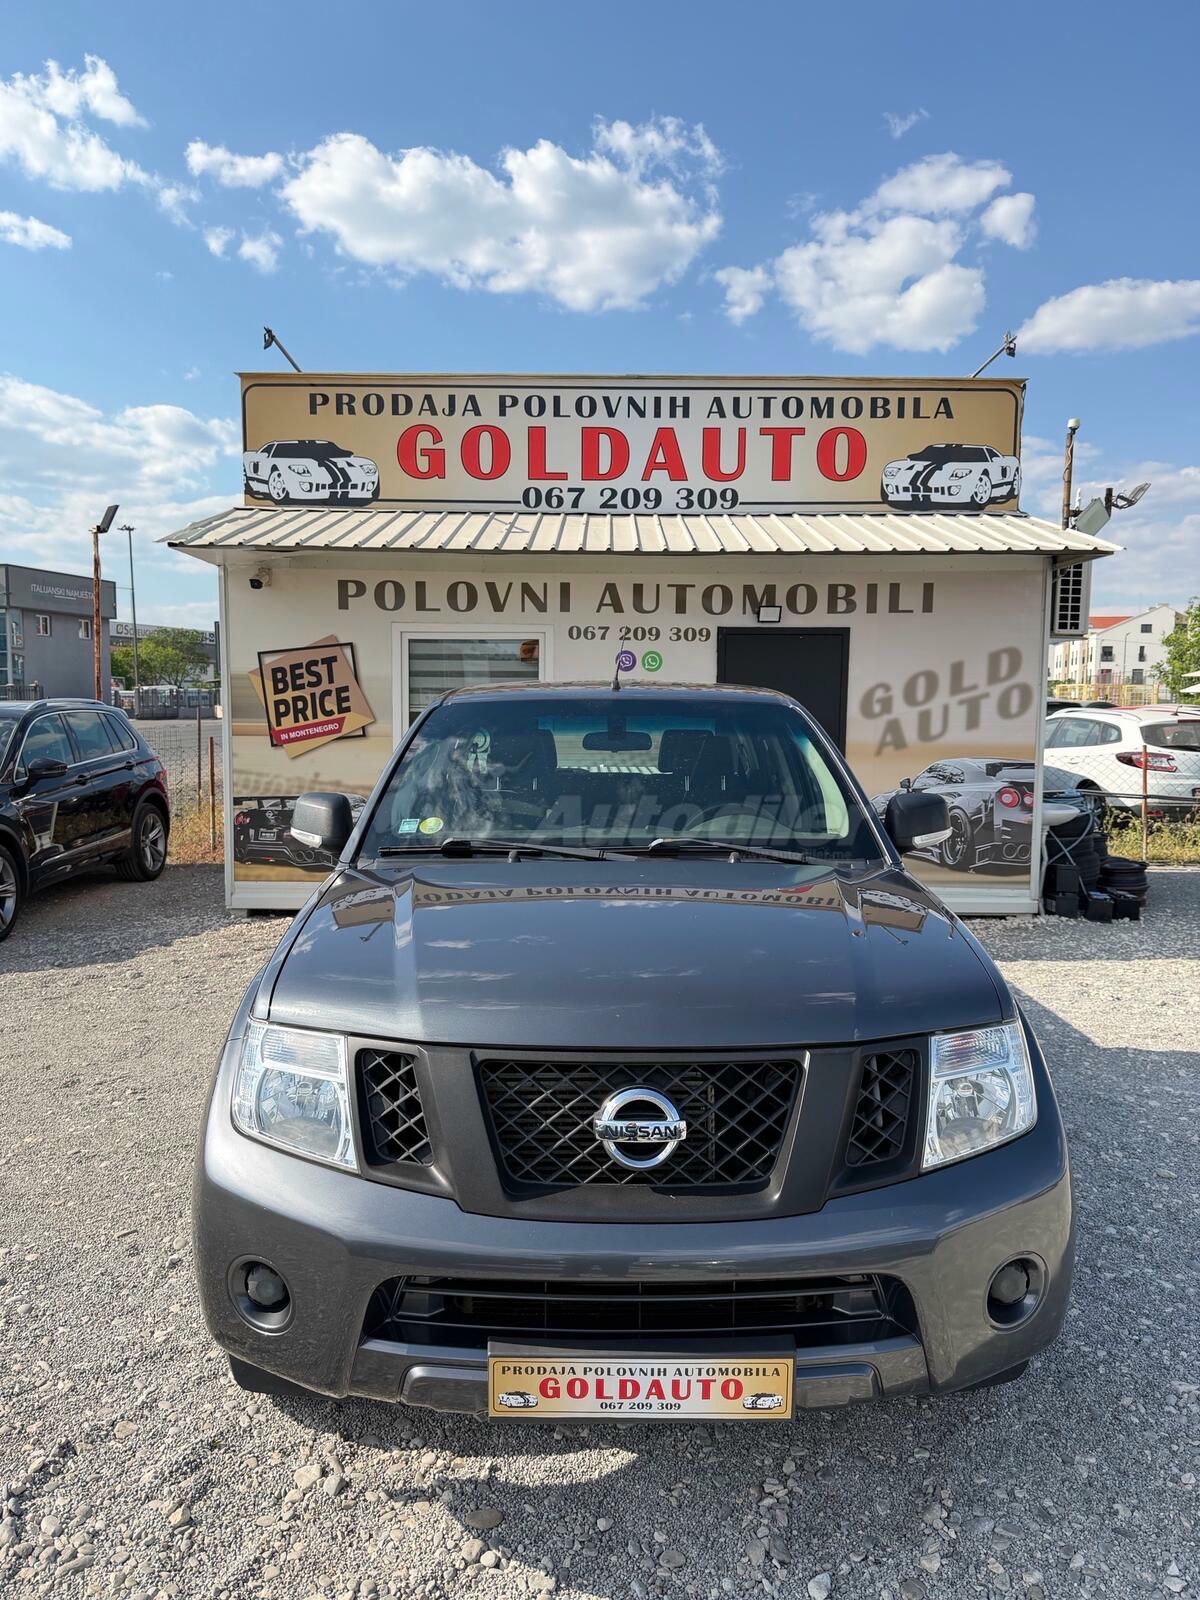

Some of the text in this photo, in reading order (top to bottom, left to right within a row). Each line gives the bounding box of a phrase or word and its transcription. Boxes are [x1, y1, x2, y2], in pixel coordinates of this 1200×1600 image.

[309, 392, 954, 420] PRODAJA POLOVNIH AUTOMOBILA
[397, 424, 867, 482] GOLDAUTO
[522, 487, 739, 510] 067 209 309
[337, 579, 934, 615] POLOVNI AUTOMOBILI
[568, 626, 711, 642] 067 209 309
[271, 656, 338, 695] BEST
[860, 646, 1023, 720] GOLD
[274, 685, 351, 727] PRICE
[289, 722, 340, 739] MONTENEGRO
[874, 682, 1034, 757] AUTO
[605, 1125, 677, 1138] NISSAN
[501, 1365, 781, 1377] PRODAJA POLOVNIH AUTOMOBILA
[538, 1377, 743, 1401] GOLDAUTO
[600, 1402, 681, 1411] 067 209 309
